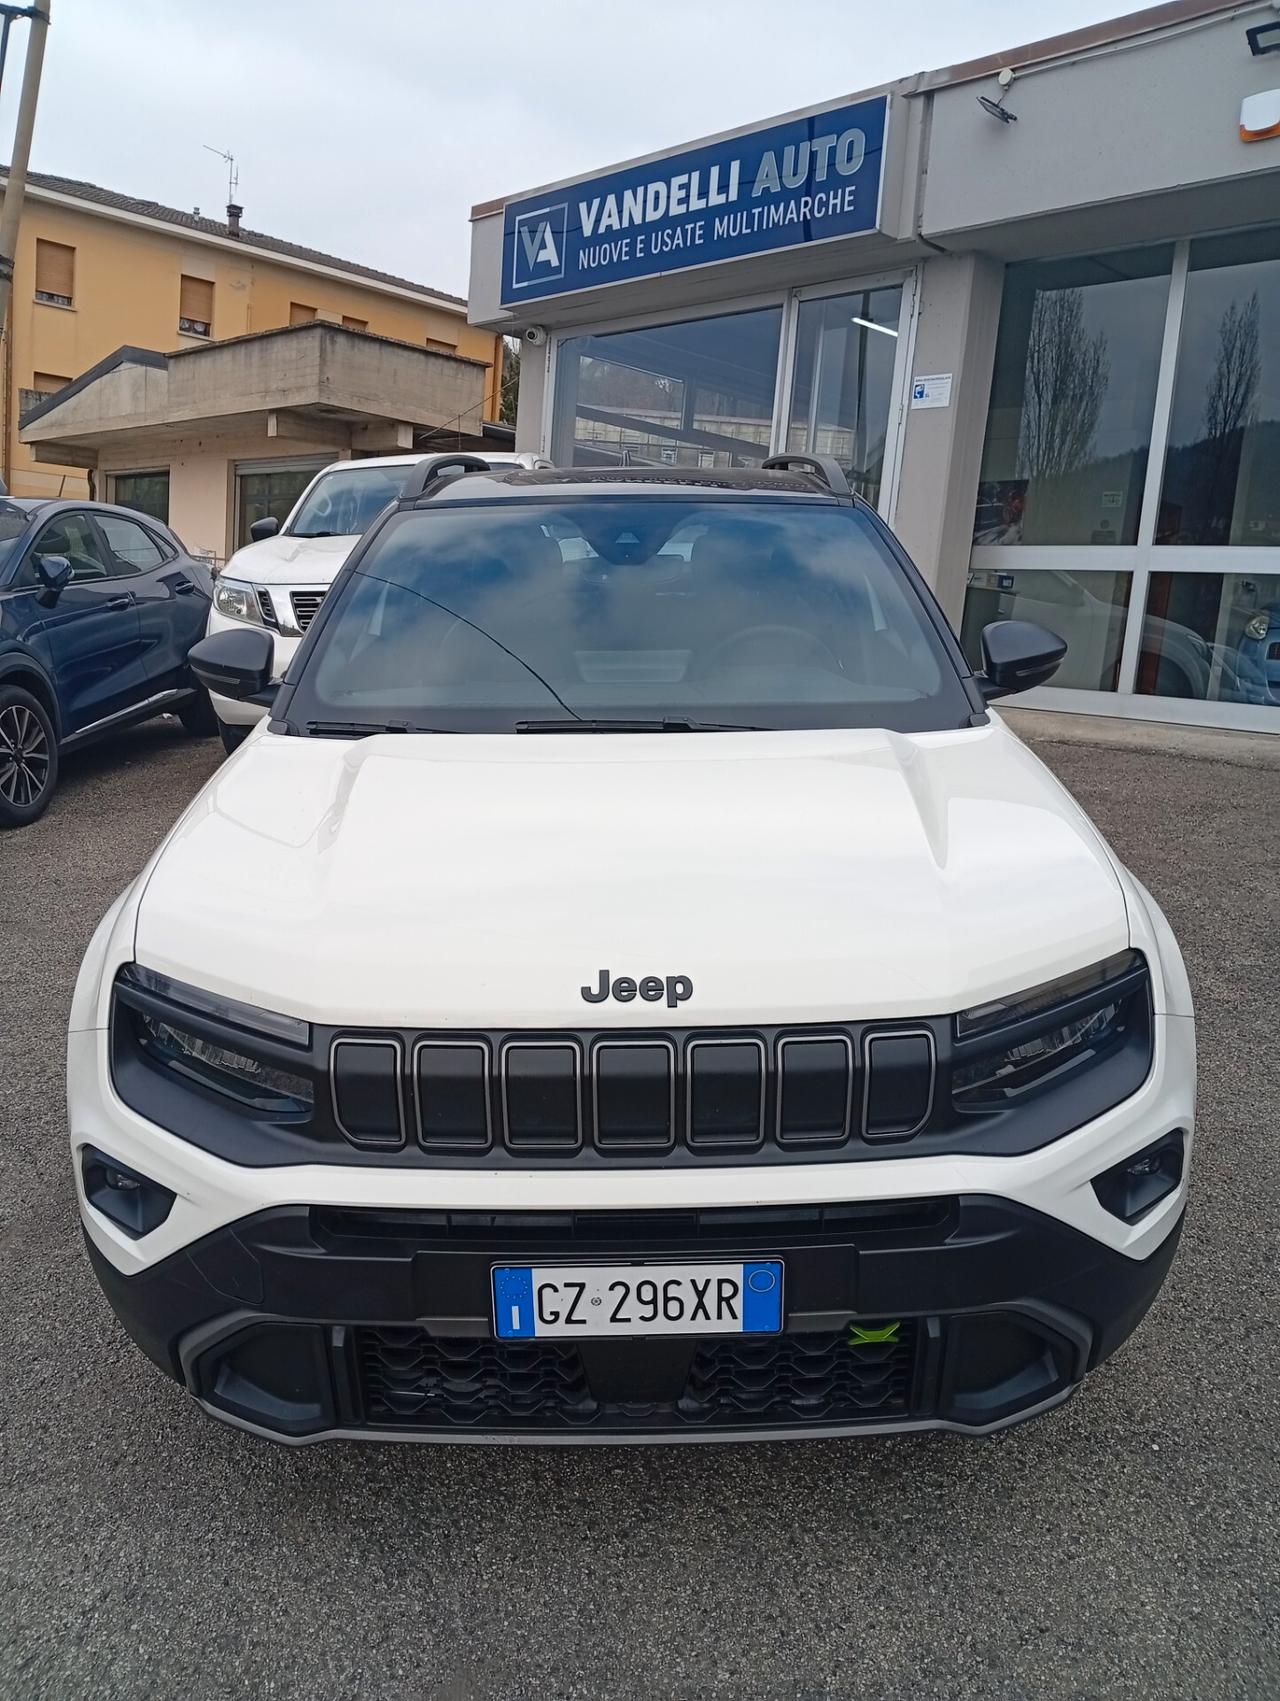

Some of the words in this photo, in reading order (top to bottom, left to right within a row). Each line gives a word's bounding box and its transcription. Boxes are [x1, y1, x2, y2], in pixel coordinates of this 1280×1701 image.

[579, 159, 741, 239] VANDELLI
[751, 127, 866, 197] AUTO
[520, 221, 560, 272] VA
[578, 237, 631, 271] NUOVE
[636, 234, 645, 258] E
[651, 221, 705, 256] USATE
[713, 185, 856, 241] MULTIMARCHE
[581, 969, 693, 1008] Jeep
[537, 1282, 587, 1325] GZ
[608, 1278, 739, 1323] 296XR
